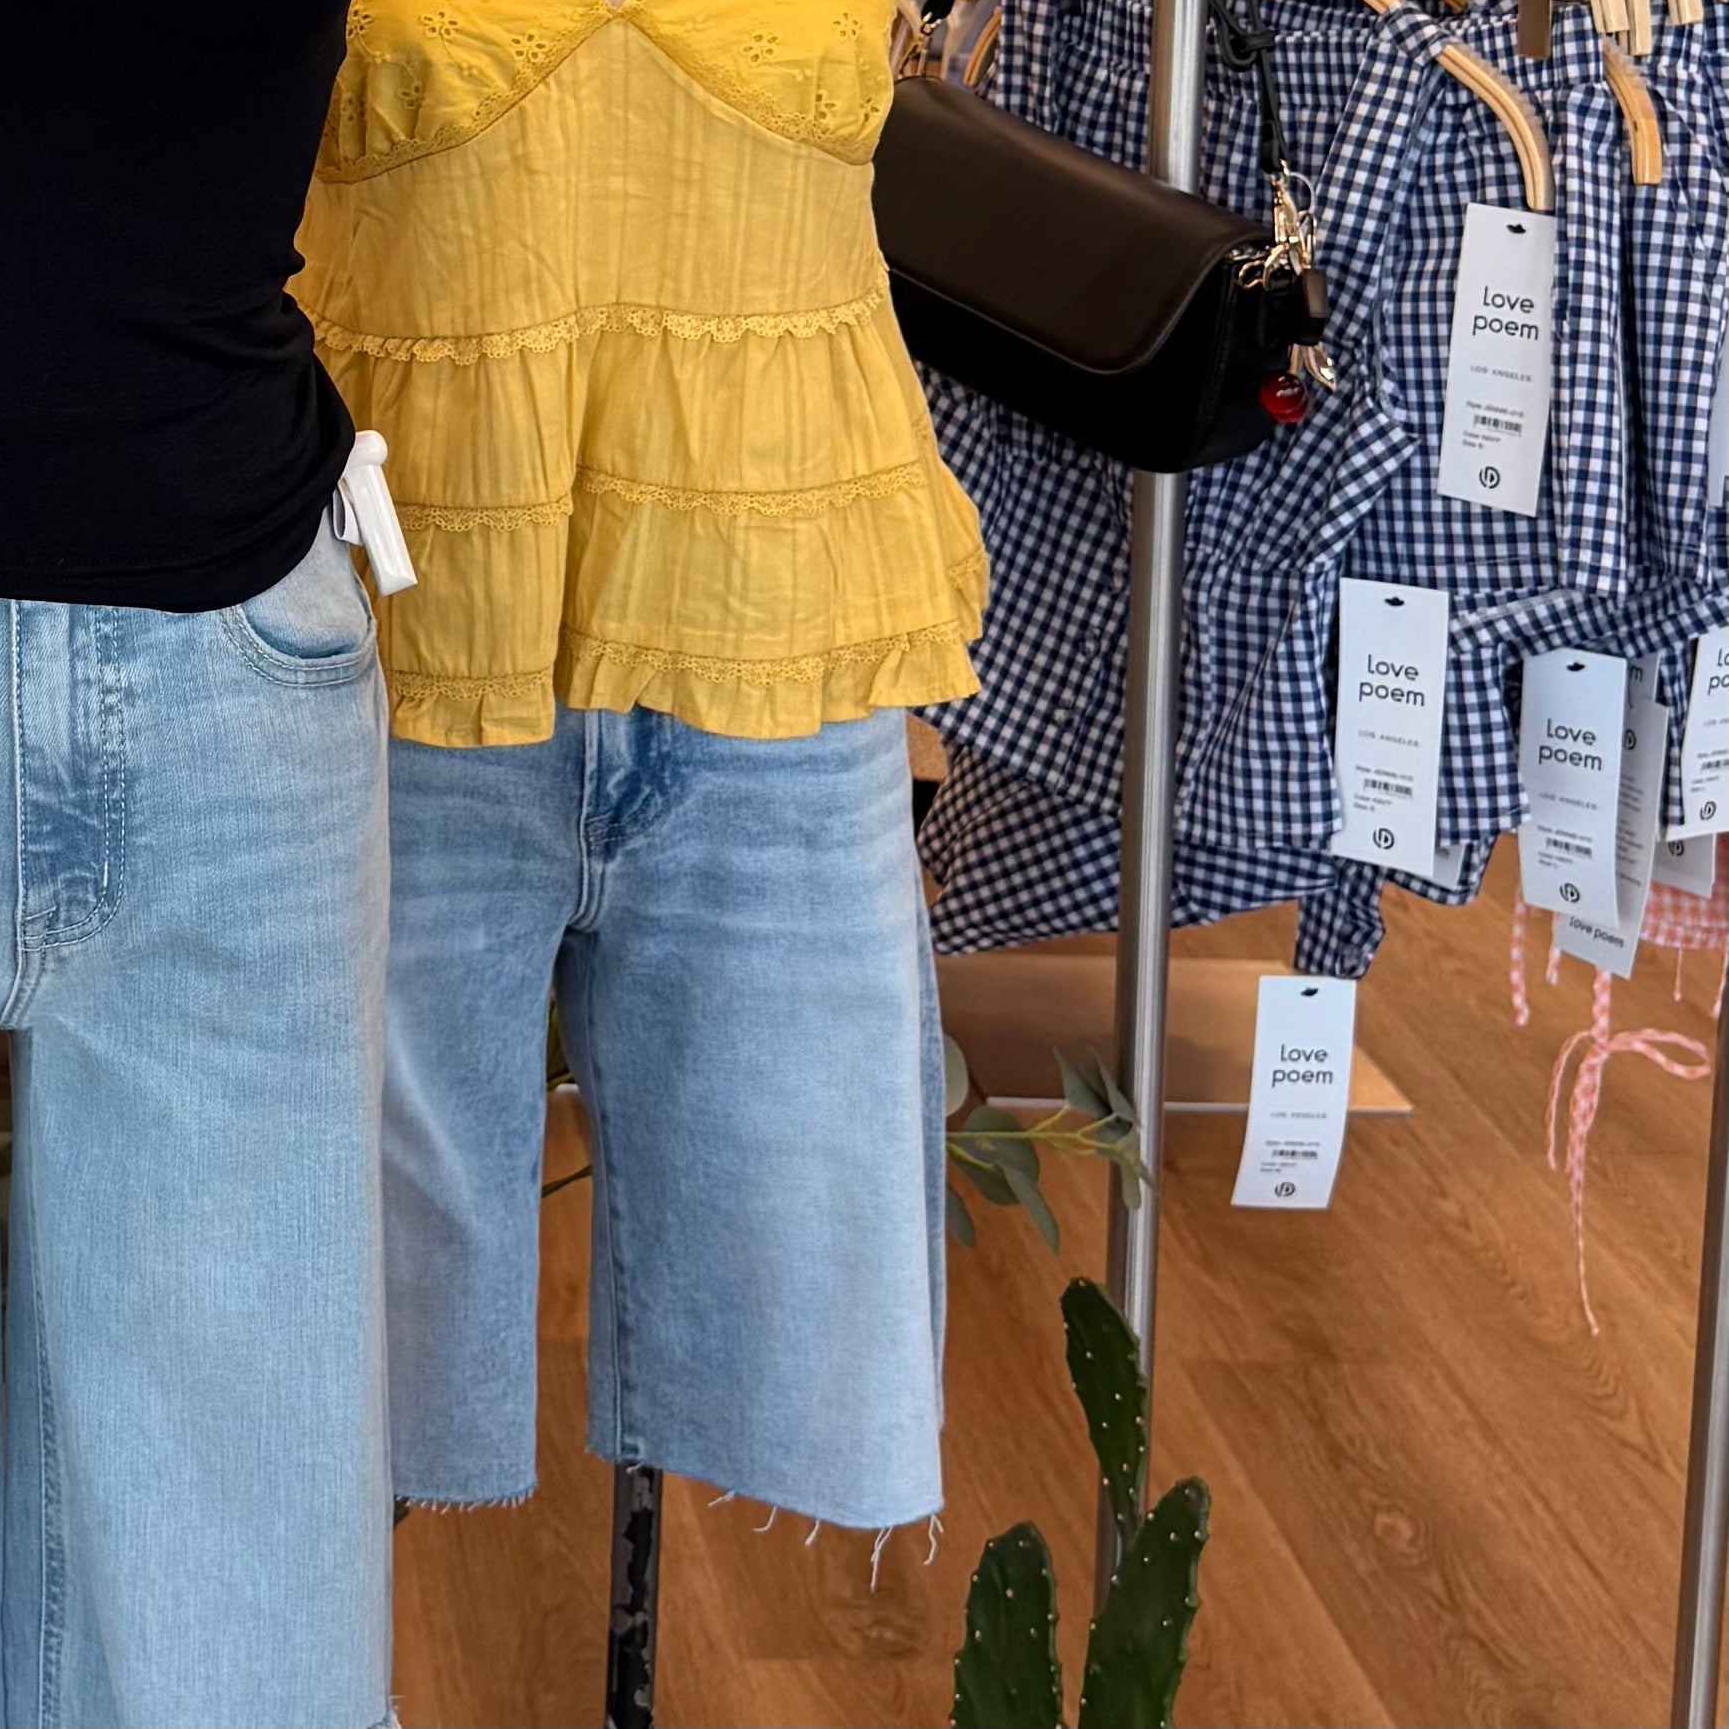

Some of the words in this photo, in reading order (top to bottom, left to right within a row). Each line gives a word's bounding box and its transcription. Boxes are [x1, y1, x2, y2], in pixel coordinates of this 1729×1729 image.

[1471, 314, 1539, 341] poem
[1358, 681, 1425, 707] poem
[1538, 745, 1603, 771] poem
[1271, 1069, 1333, 1088] poem
